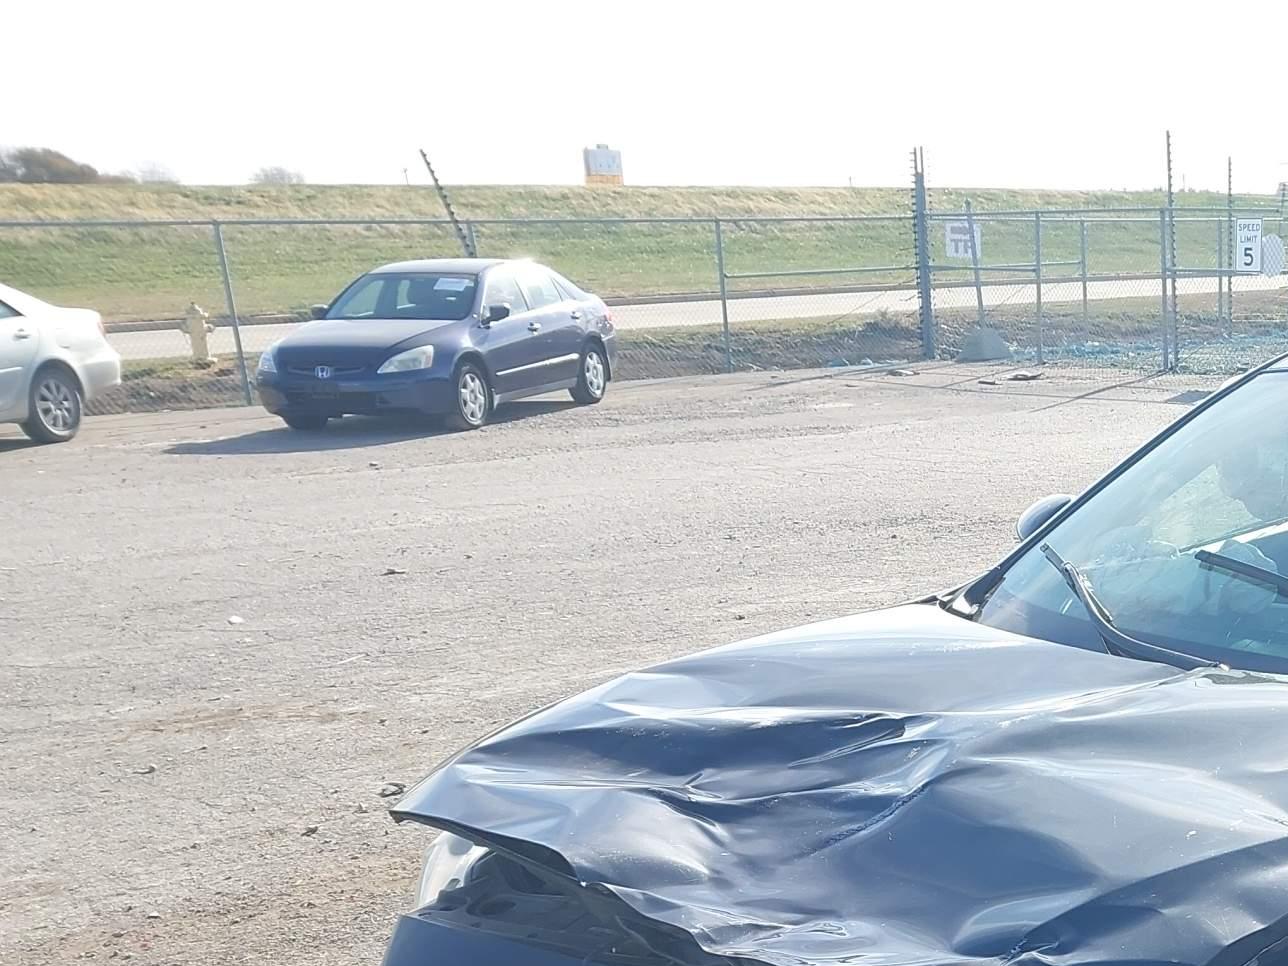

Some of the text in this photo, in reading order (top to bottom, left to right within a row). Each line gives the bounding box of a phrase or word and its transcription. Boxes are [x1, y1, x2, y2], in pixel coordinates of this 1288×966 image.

[1238, 223, 1260, 231] SPEED
[1240, 235, 1257, 243] LIMIT
[1243, 247, 1253, 266] 5
